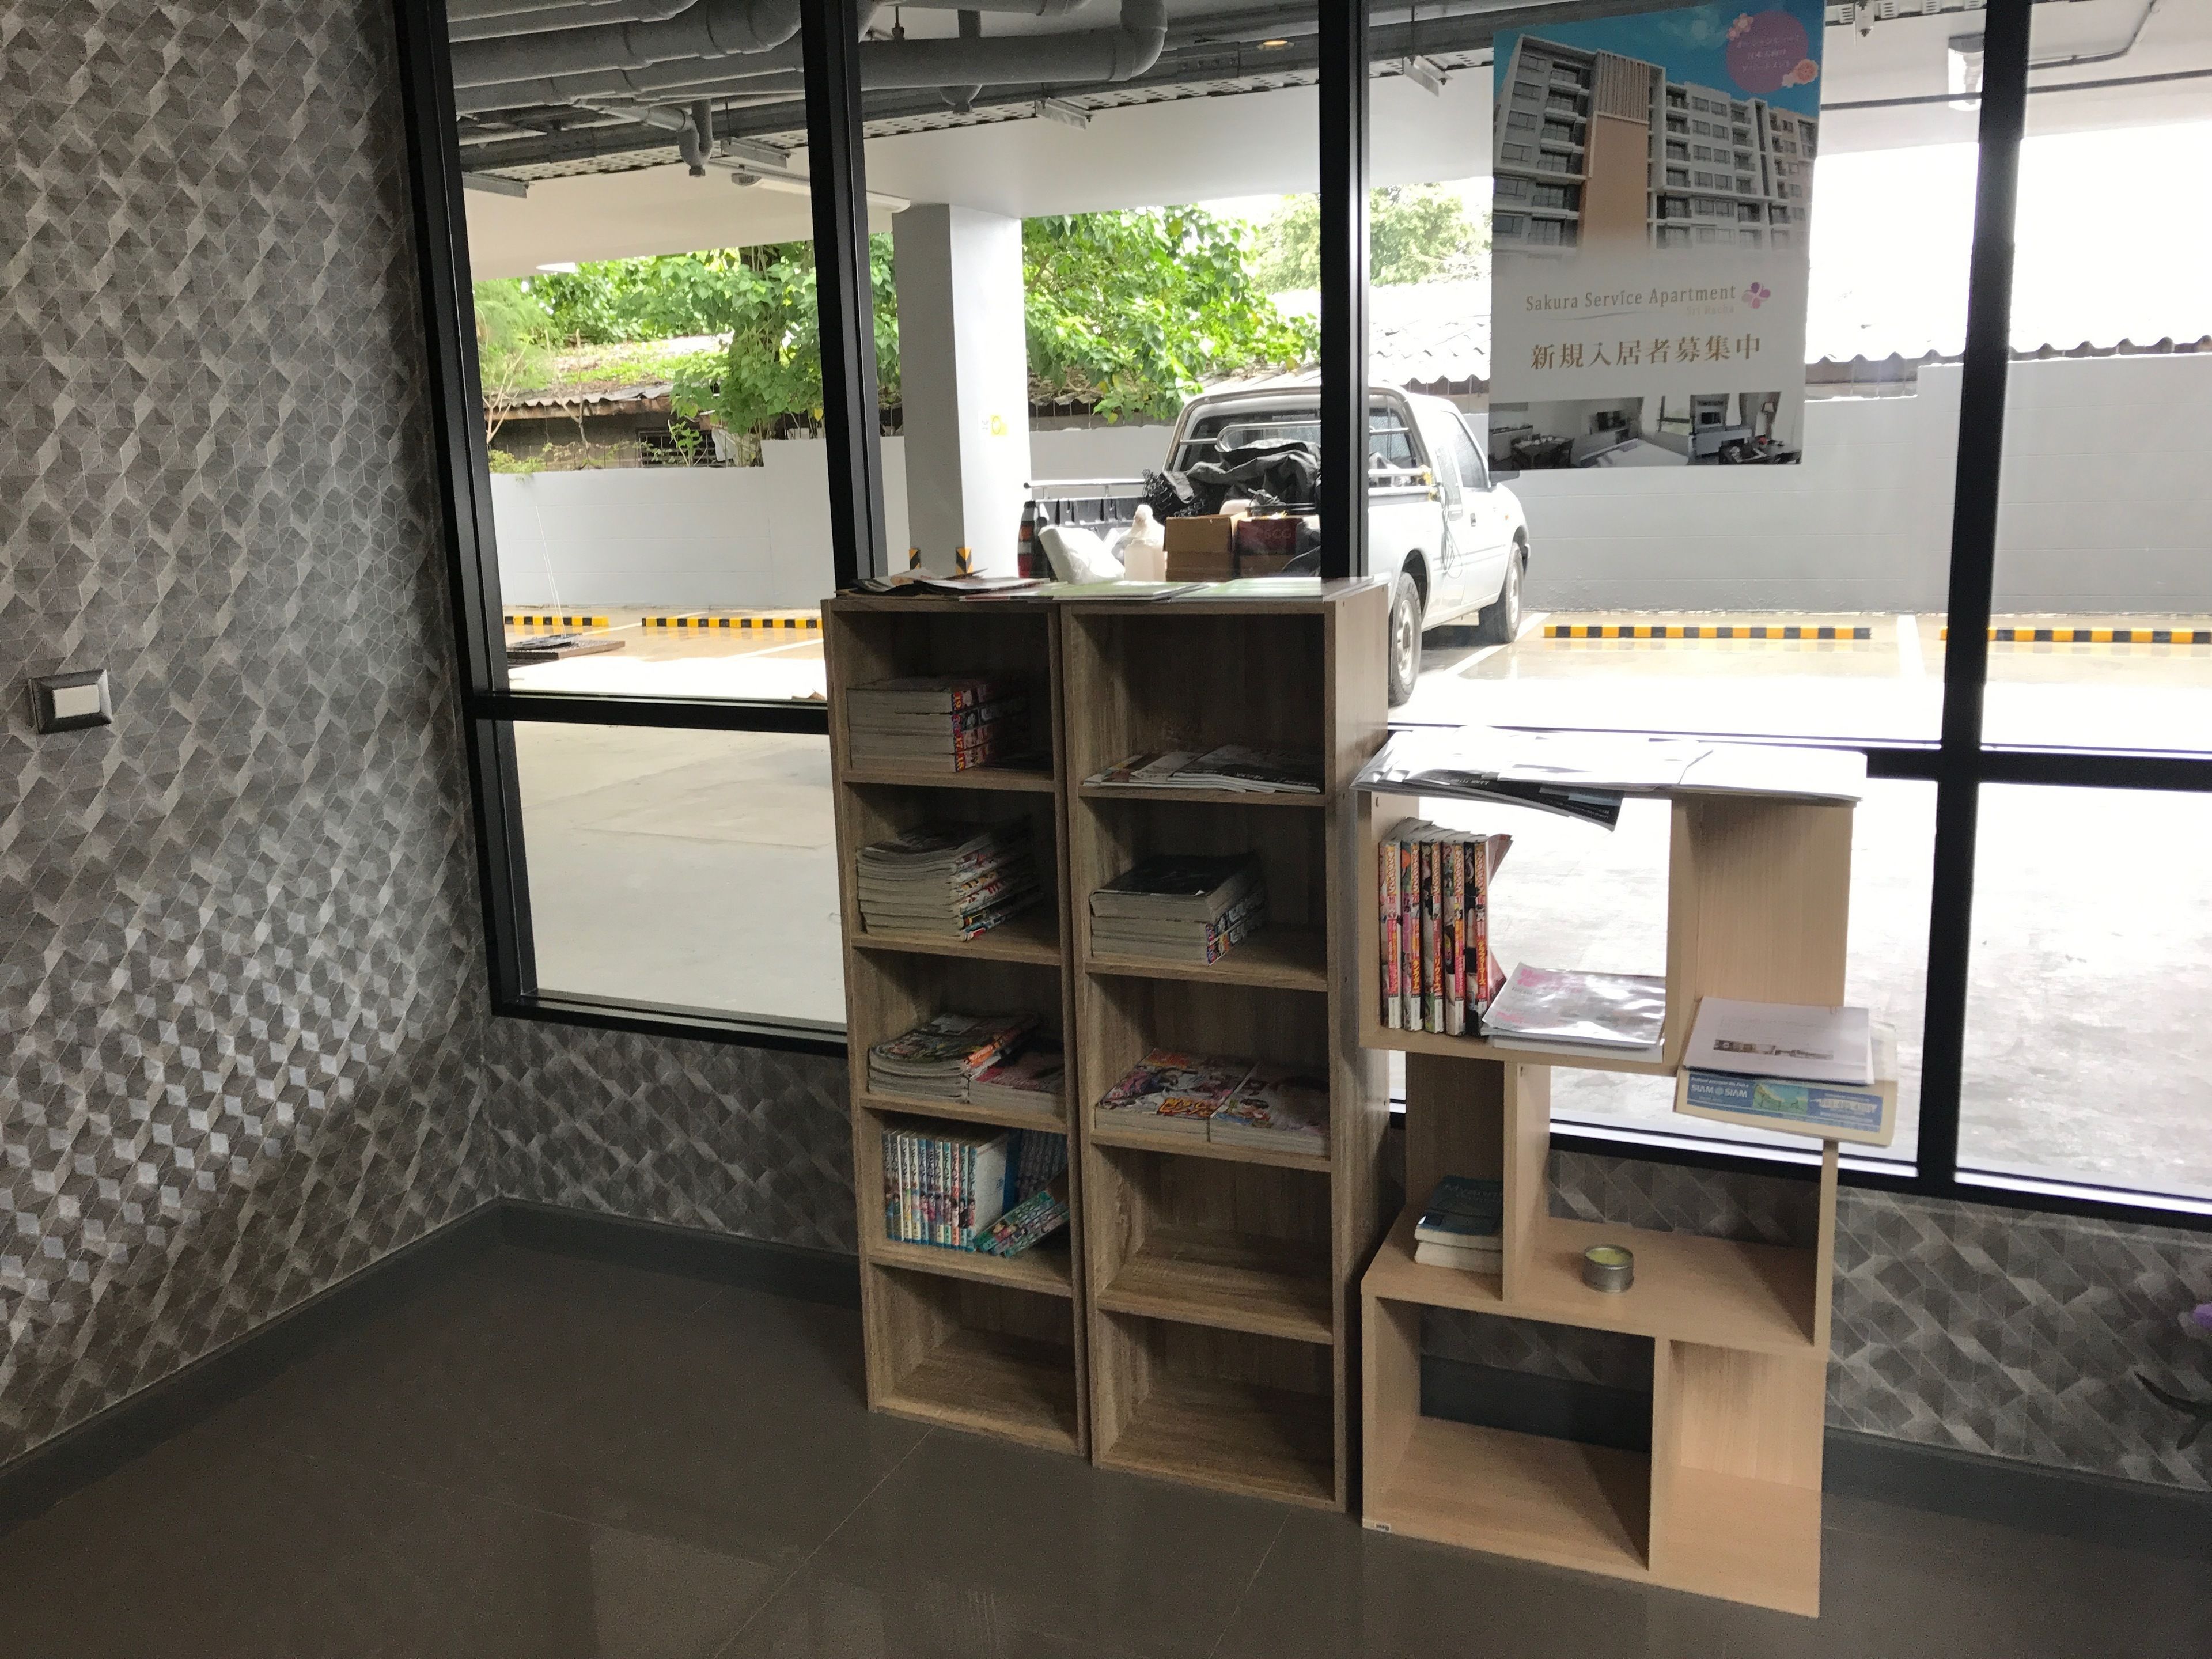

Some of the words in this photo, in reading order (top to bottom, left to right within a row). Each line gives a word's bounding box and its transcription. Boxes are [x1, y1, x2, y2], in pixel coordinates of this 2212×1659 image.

[1525, 293, 1578, 312] Sakura
[1585, 289, 1643, 308] Service
[1648, 285, 1736, 306] Apartment
[1530, 333, 1762, 371] 新規入居者募集中
[1724, 1087, 1748, 1099] SIAM
